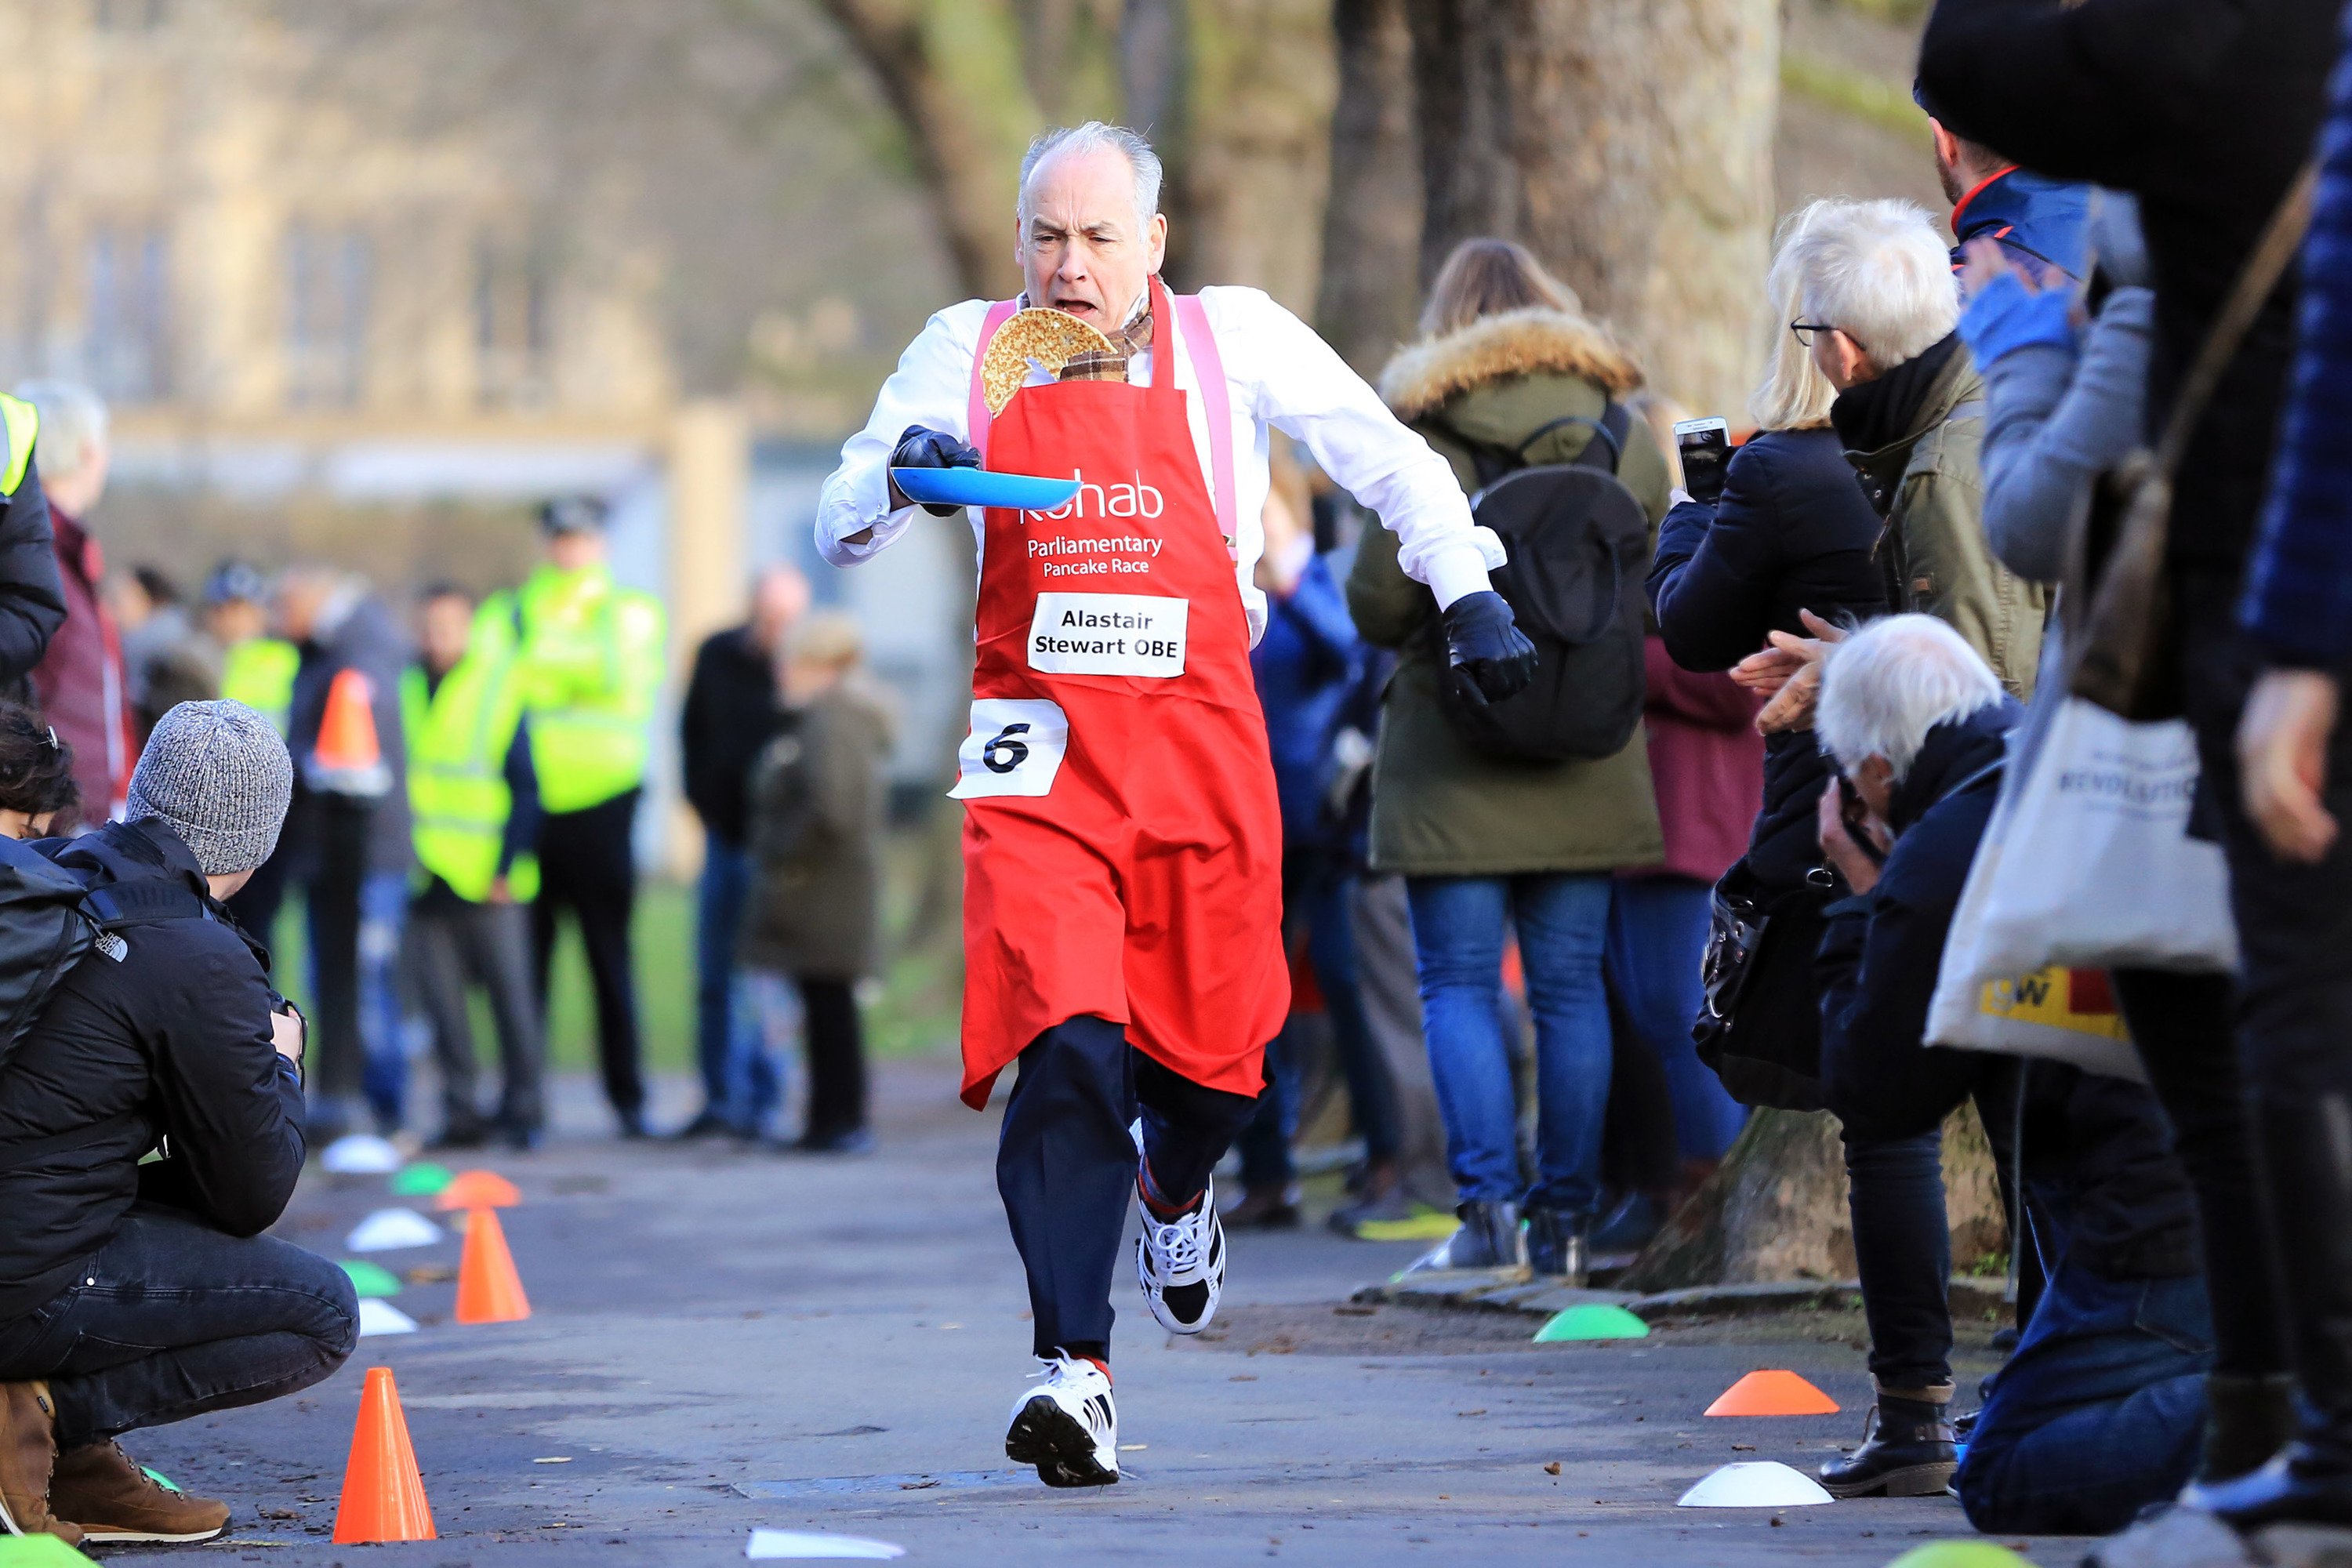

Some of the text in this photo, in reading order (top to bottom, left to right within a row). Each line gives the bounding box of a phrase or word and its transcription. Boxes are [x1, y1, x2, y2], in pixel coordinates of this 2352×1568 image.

[1019, 468, 1164, 524] hab
[1028, 535, 1163, 558] Parliamentary
[1044, 557, 1149, 578] Pancake Race
[1062, 610, 1153, 630] Alastair
[1035, 635, 1178, 659] Stewart OBE
[983, 723, 1031, 774] 6
